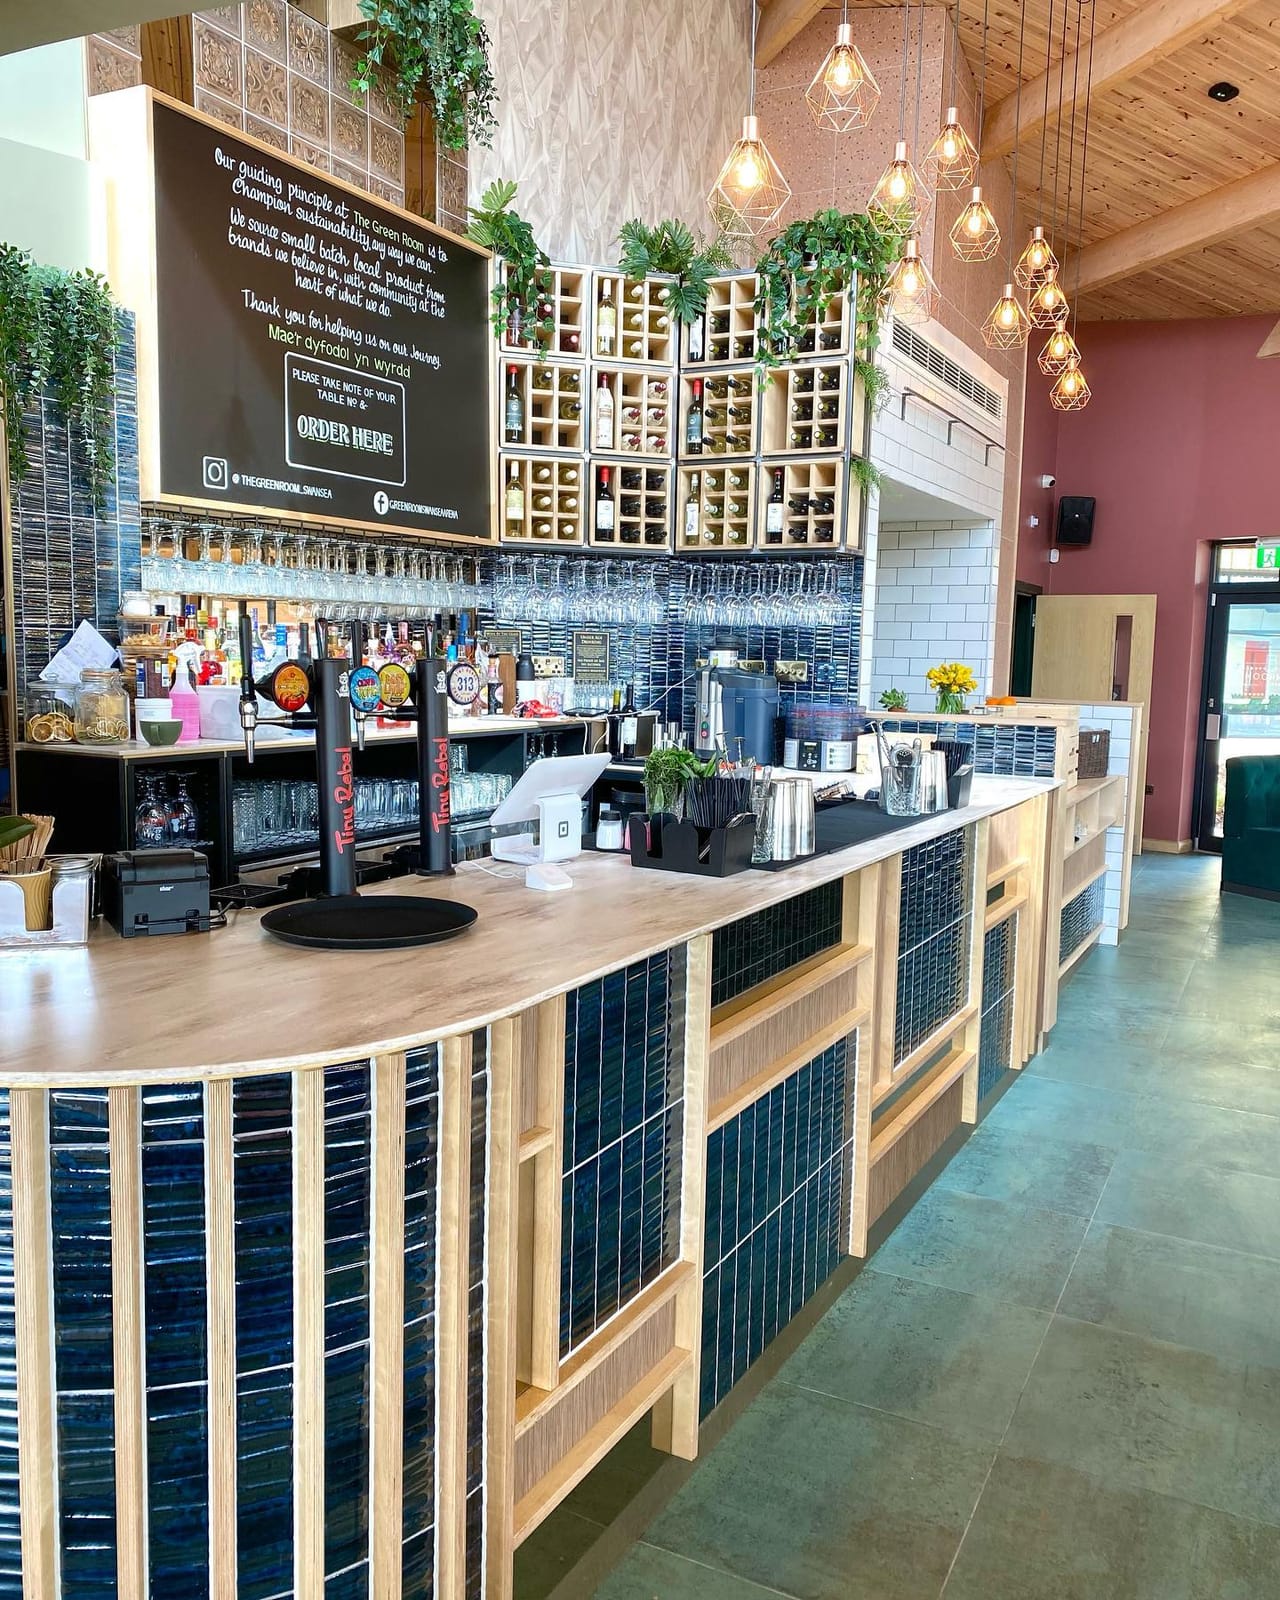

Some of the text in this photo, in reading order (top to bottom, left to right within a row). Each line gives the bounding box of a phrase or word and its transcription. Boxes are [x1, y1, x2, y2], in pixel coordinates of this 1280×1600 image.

[214, 147, 448, 262] Our guiding principle at The Green Room is to
[232, 177, 293, 216] Champion
[371, 239, 386, 260] any
[387, 245, 404, 267] way
[405, 252, 416, 266] we
[228, 226, 272, 257] brands
[274, 248, 289, 263] we
[291, 250, 325, 275] believe
[344, 272, 366, 290] with
[368, 281, 418, 313] community
[418, 298, 430, 313] at
[430, 301, 446, 319] the
[230, 206, 446, 304] We source small batch local product from
[294, 269, 392, 317] heart of what we do.
[241, 288, 281, 318] Thank
[284, 308, 306, 325] you
[308, 309, 324, 330] for
[324, 314, 362, 347] helping
[365, 333, 378, 347] us
[378, 338, 391, 352] on
[392, 342, 409, 357] our
[304, 335, 350, 361] dyfodol
[354, 352, 370, 369] yn
[373, 357, 411, 379] wyrdd
[292, 367, 397, 405] PLEASE TAKE NOTE OF YOUR
[317, 388, 345, 405] TABLE
[297, 414, 394, 456] ORDER HERE
[457, 676, 474, 691] 313
[334, 746, 353, 804] Rebel
[431, 737, 449, 788] Rebel
